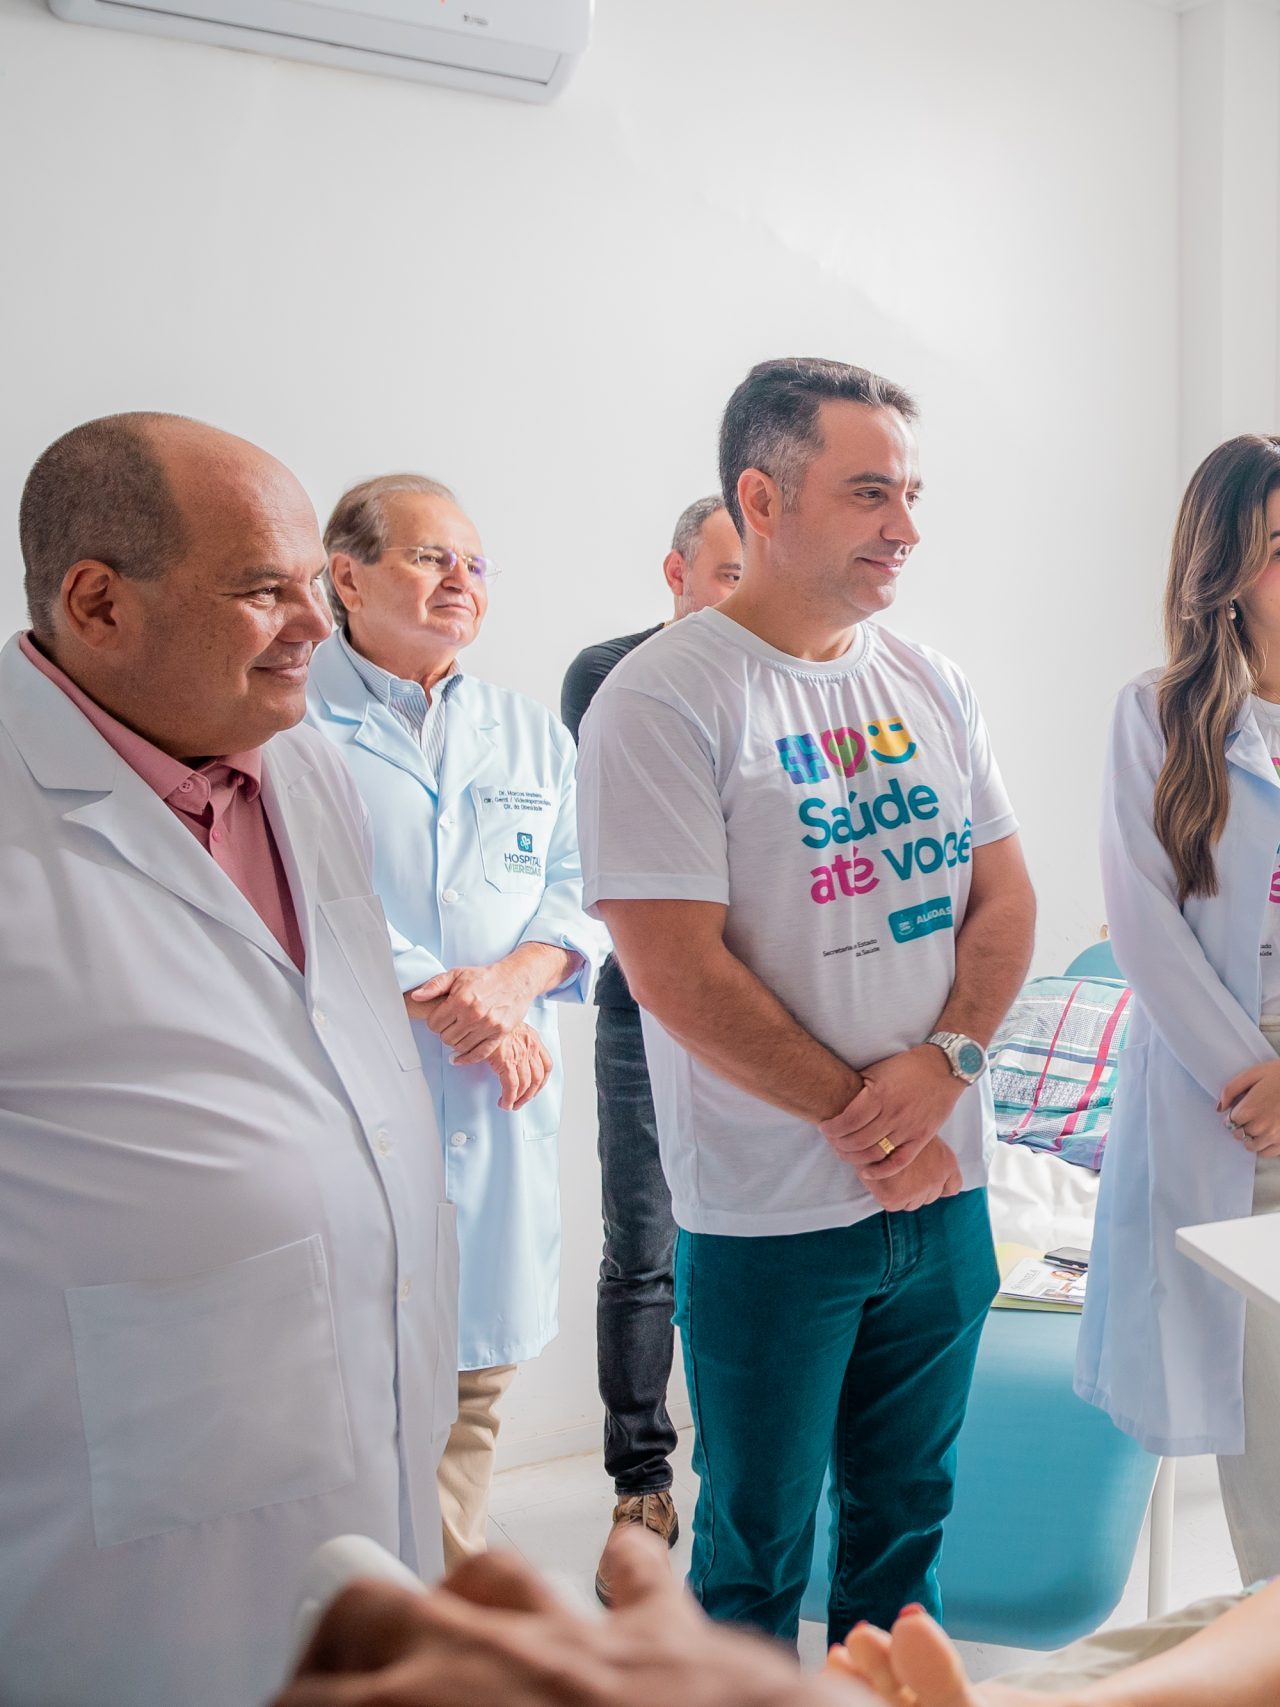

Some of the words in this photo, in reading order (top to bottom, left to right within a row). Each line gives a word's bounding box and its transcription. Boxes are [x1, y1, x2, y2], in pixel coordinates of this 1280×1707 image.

[798, 778, 939, 849] Saúde
[809, 845, 881, 905] até
[881, 817, 972, 881] você
